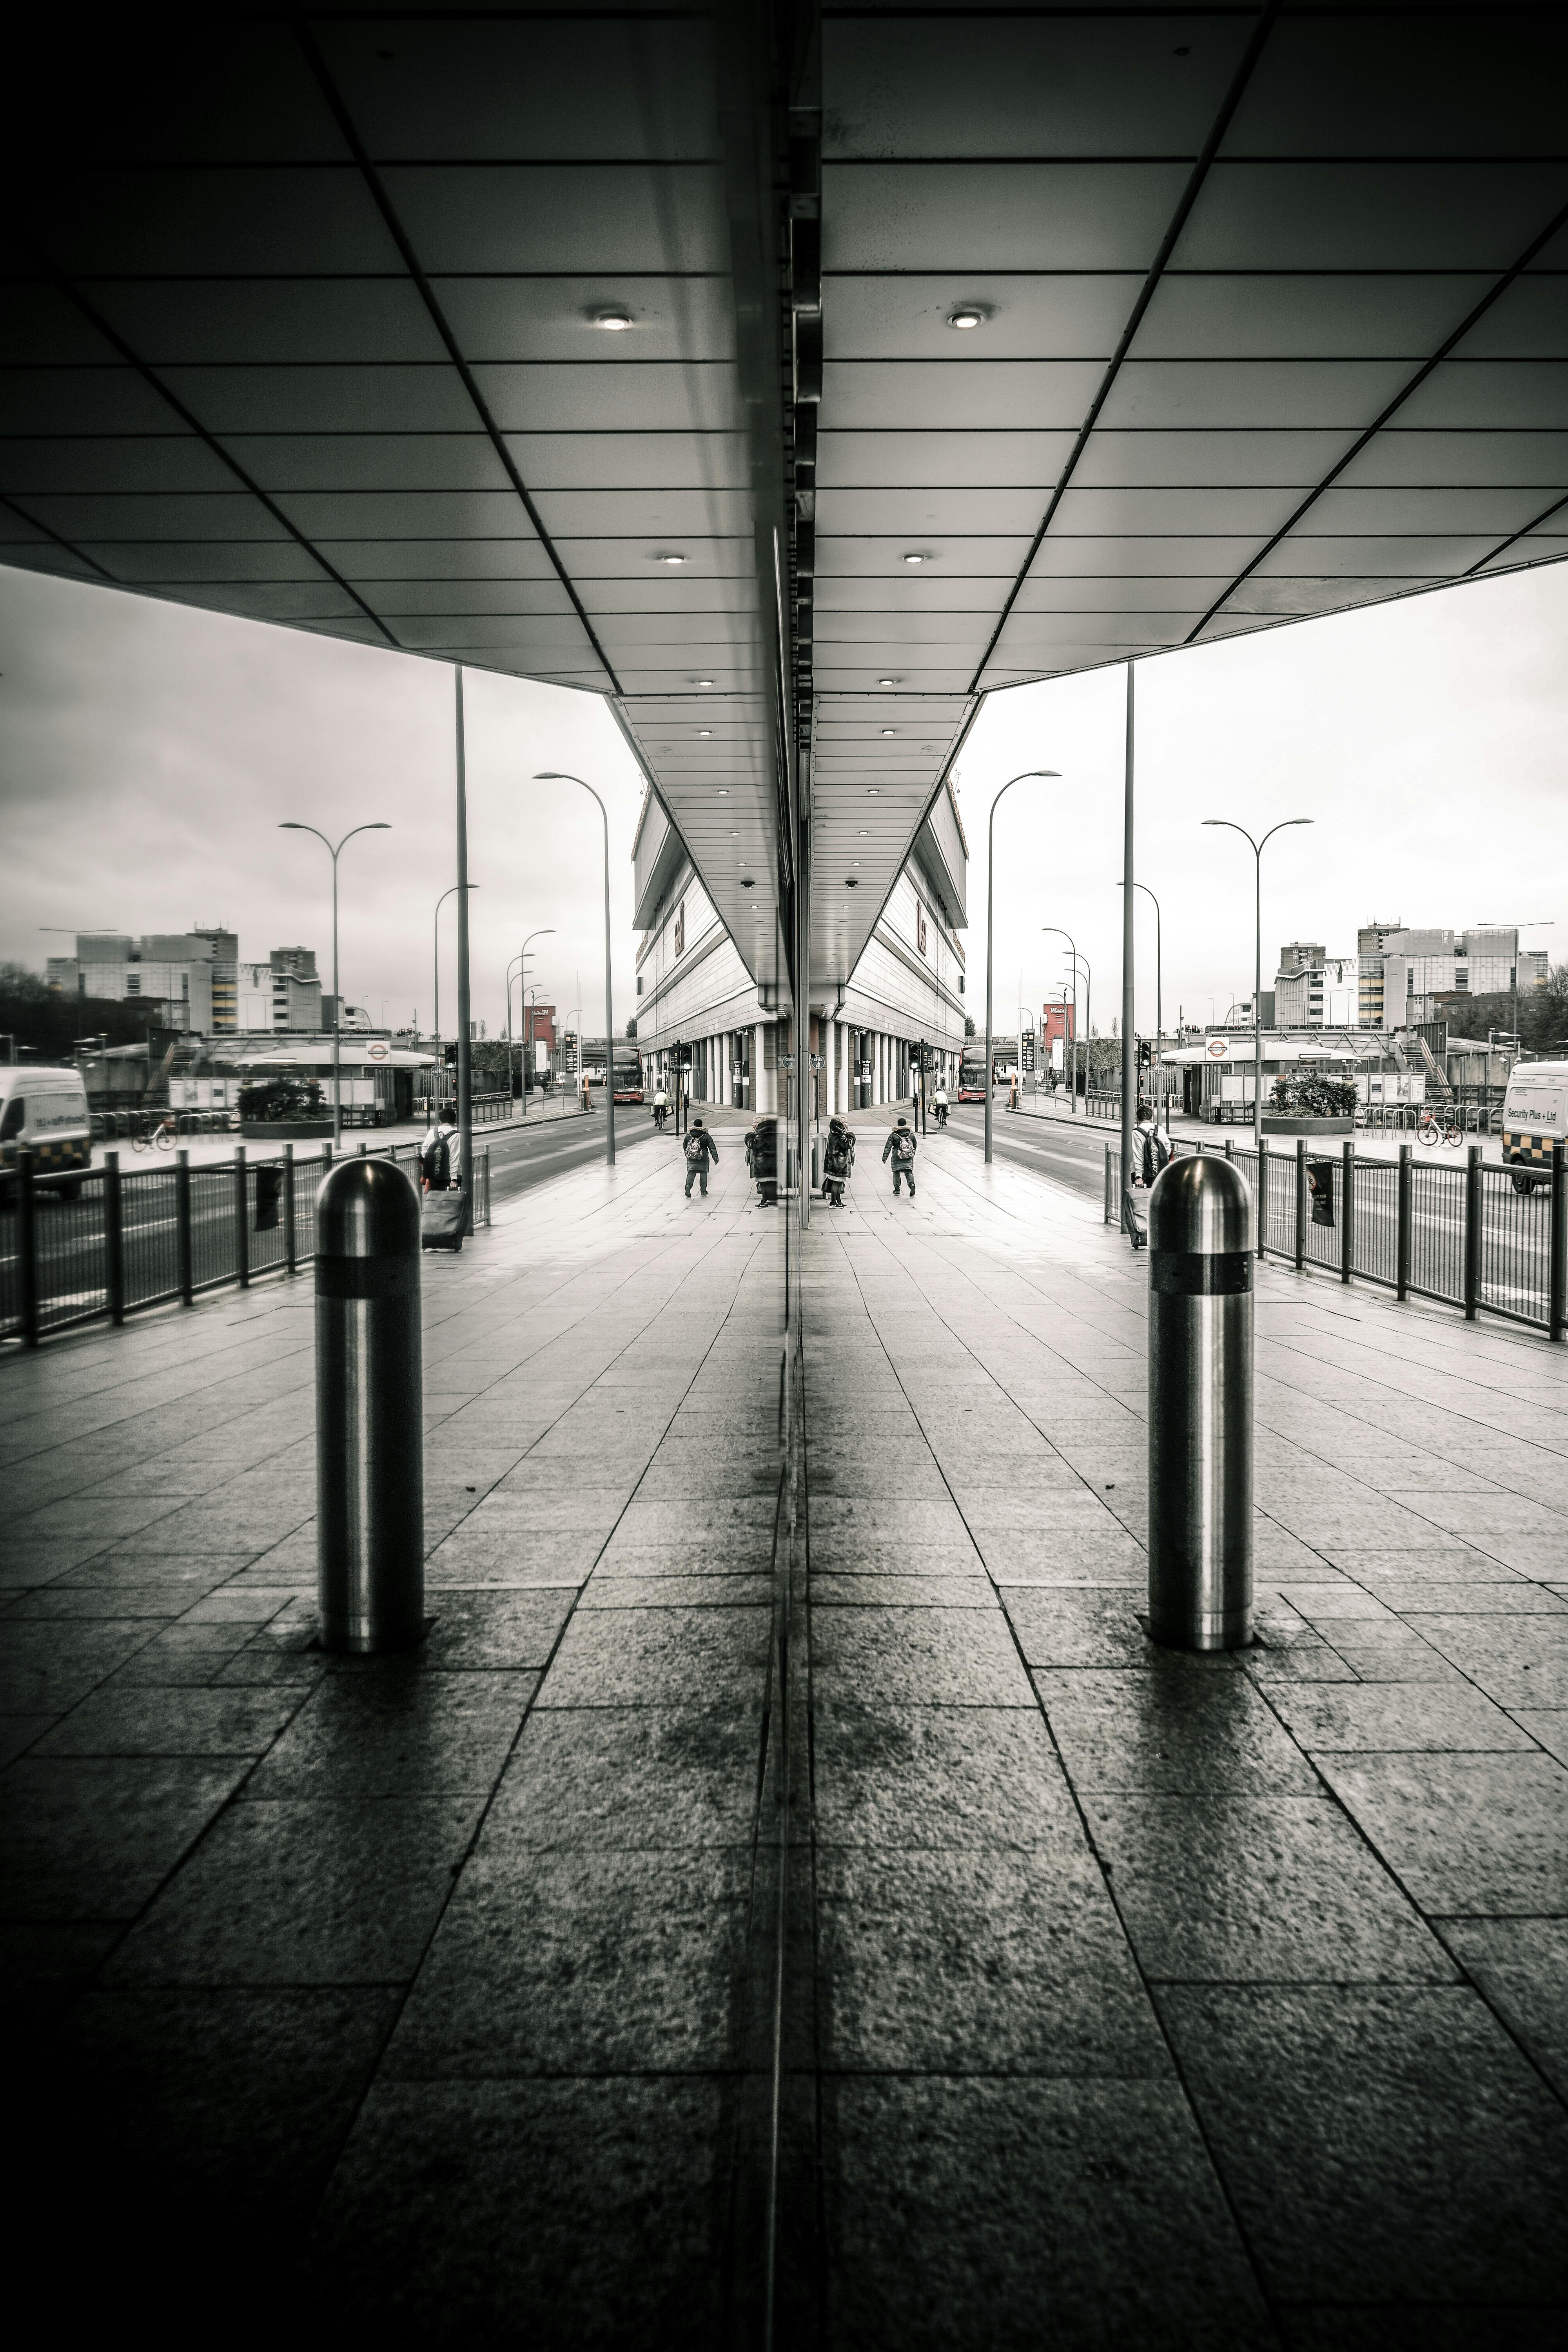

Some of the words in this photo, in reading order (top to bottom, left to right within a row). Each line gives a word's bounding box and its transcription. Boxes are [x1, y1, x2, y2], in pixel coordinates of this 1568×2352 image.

[1508, 1108, 1528, 1121] Security
[1529, 1110, 1541, 1120] Plus
[1547, 1111, 1556, 1121] Ltd
